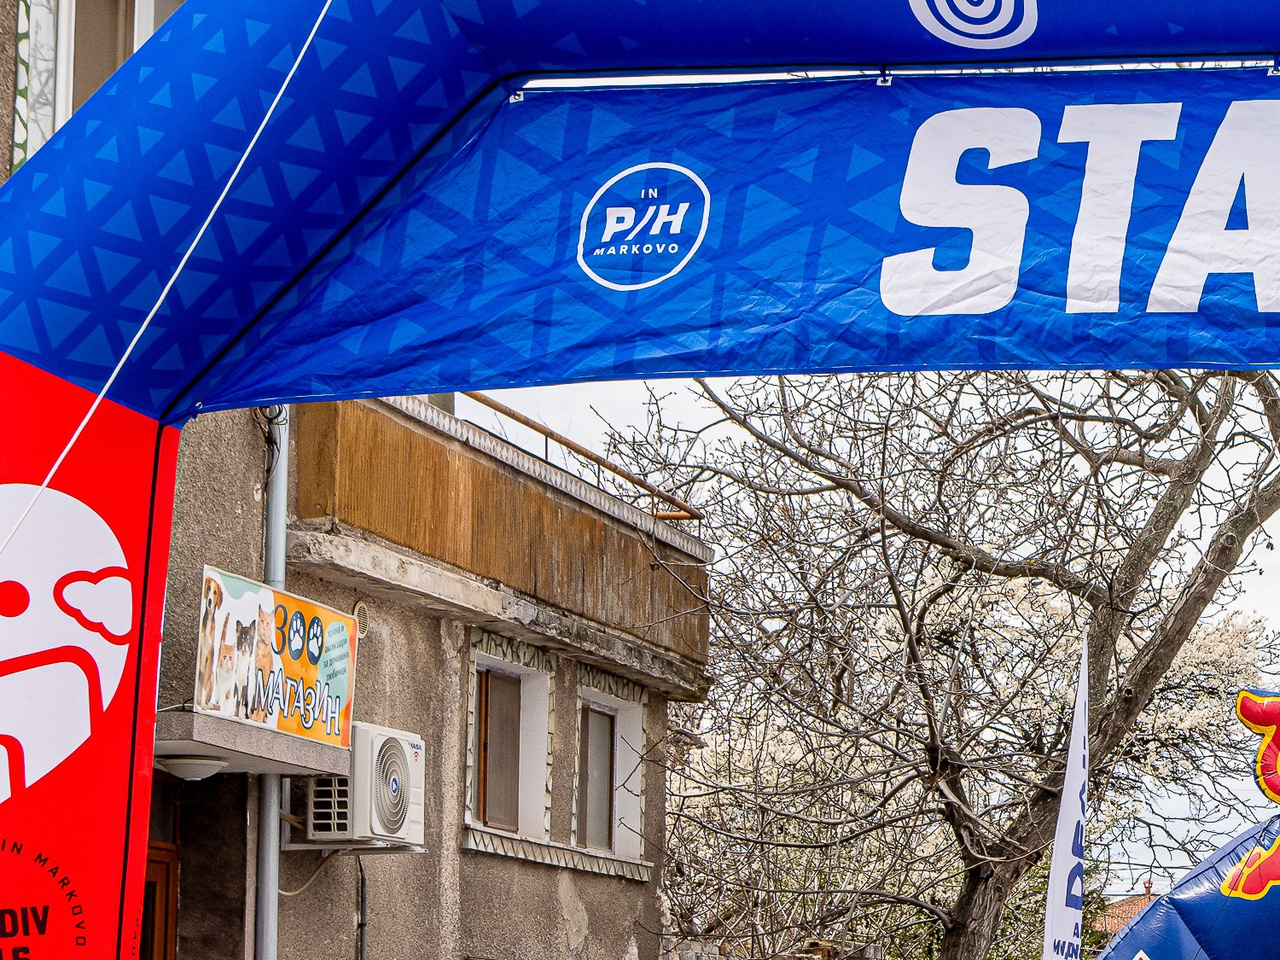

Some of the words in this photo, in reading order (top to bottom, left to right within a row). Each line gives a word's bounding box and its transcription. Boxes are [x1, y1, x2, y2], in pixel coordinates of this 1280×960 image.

[641, 188, 658, 199] IN
[601, 202, 690, 243] P/H
[593, 243, 679, 256] MARKOVO
[254, 668, 341, 735] МАГАЗИН
[34, 853, 86, 946] MARKOVO
